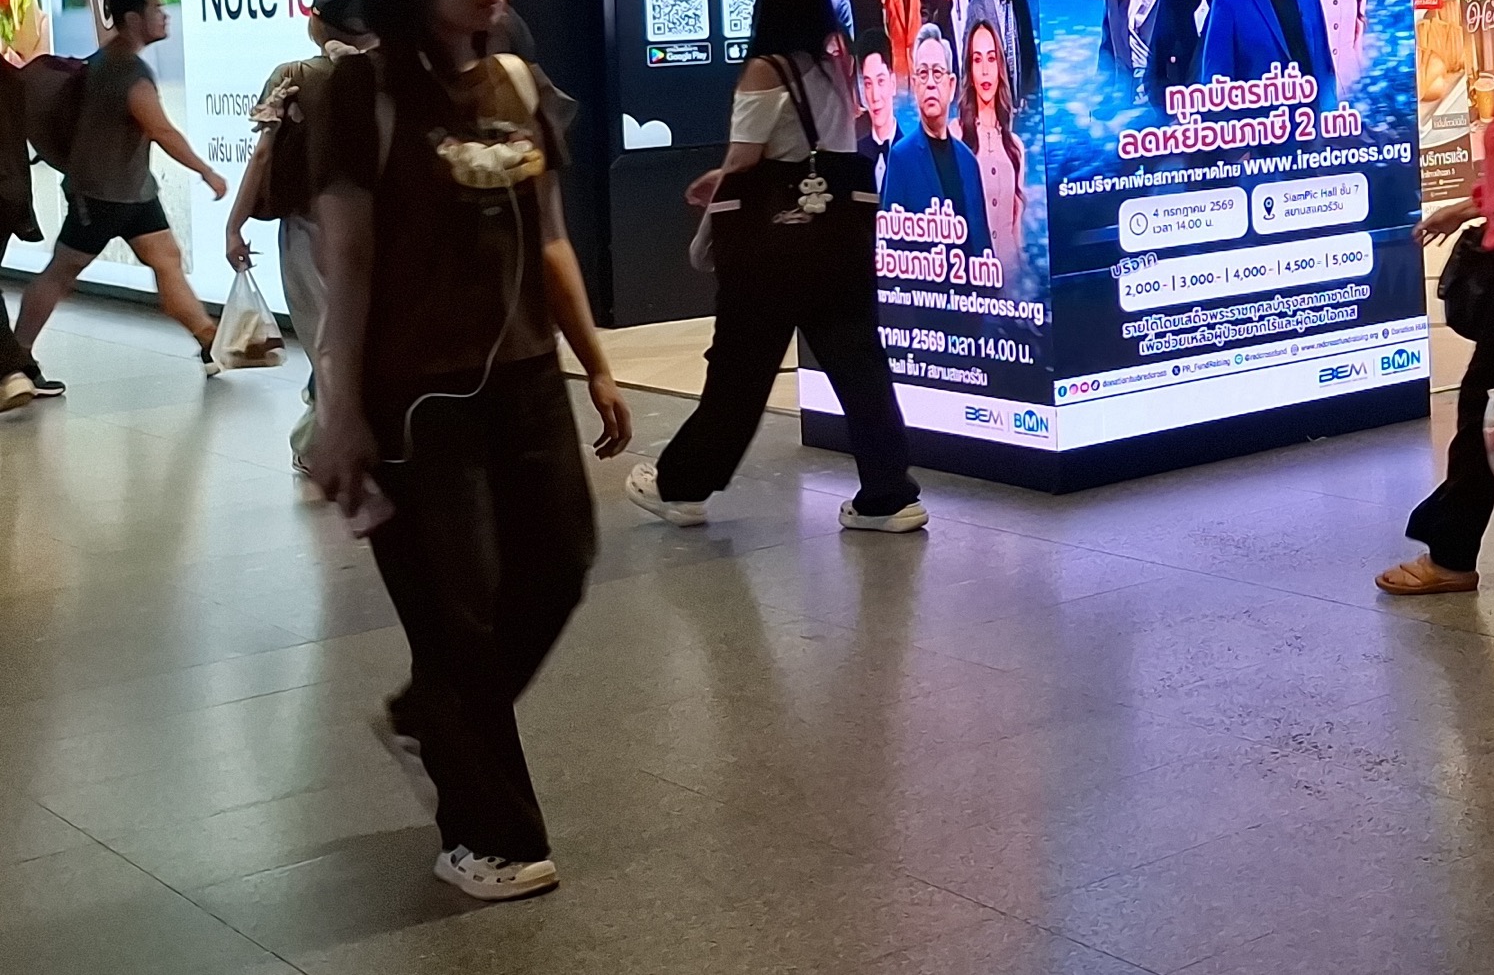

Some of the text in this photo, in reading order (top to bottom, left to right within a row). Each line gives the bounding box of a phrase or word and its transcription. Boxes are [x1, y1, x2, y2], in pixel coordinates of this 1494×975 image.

[1166, 62, 1318, 122] ทุกบัตรที่นั่ง
[1118, 101, 1363, 159] ลดหย่อนภาษี 2 เท่า
[1058, 140, 1412, 197] ร่วมบริจาคเพื่อสภากาชาดไทย www.iredcross.org
[1420, 147, 1469, 167] บริการแล้ว
[1320, 186, 1337, 199] Hall
[1354, 184, 1360, 195] 7
[1152, 208, 1160, 218] 4
[1209, 199, 1234, 212] 2569
[1152, 222, 1173, 234] เวลา
[1175, 218, 1202, 231] 14.00
[950, 248, 967, 285] 2
[968, 248, 1004, 288] เท่า
[1110, 252, 1158, 278] บริจาค
[911, 289, 1044, 326] www.iredcross.org
[911, 328, 945, 353] 2569
[947, 335, 976, 356] เวลา
[977, 337, 1017, 363] 14.00
[1018, 343, 1034, 364] น.
[919, 362, 927, 377] 7
[1318, 361, 1368, 384] BEM
[1380, 348, 1421, 373] BMN
[965, 406, 1049, 433] BEM BMN
